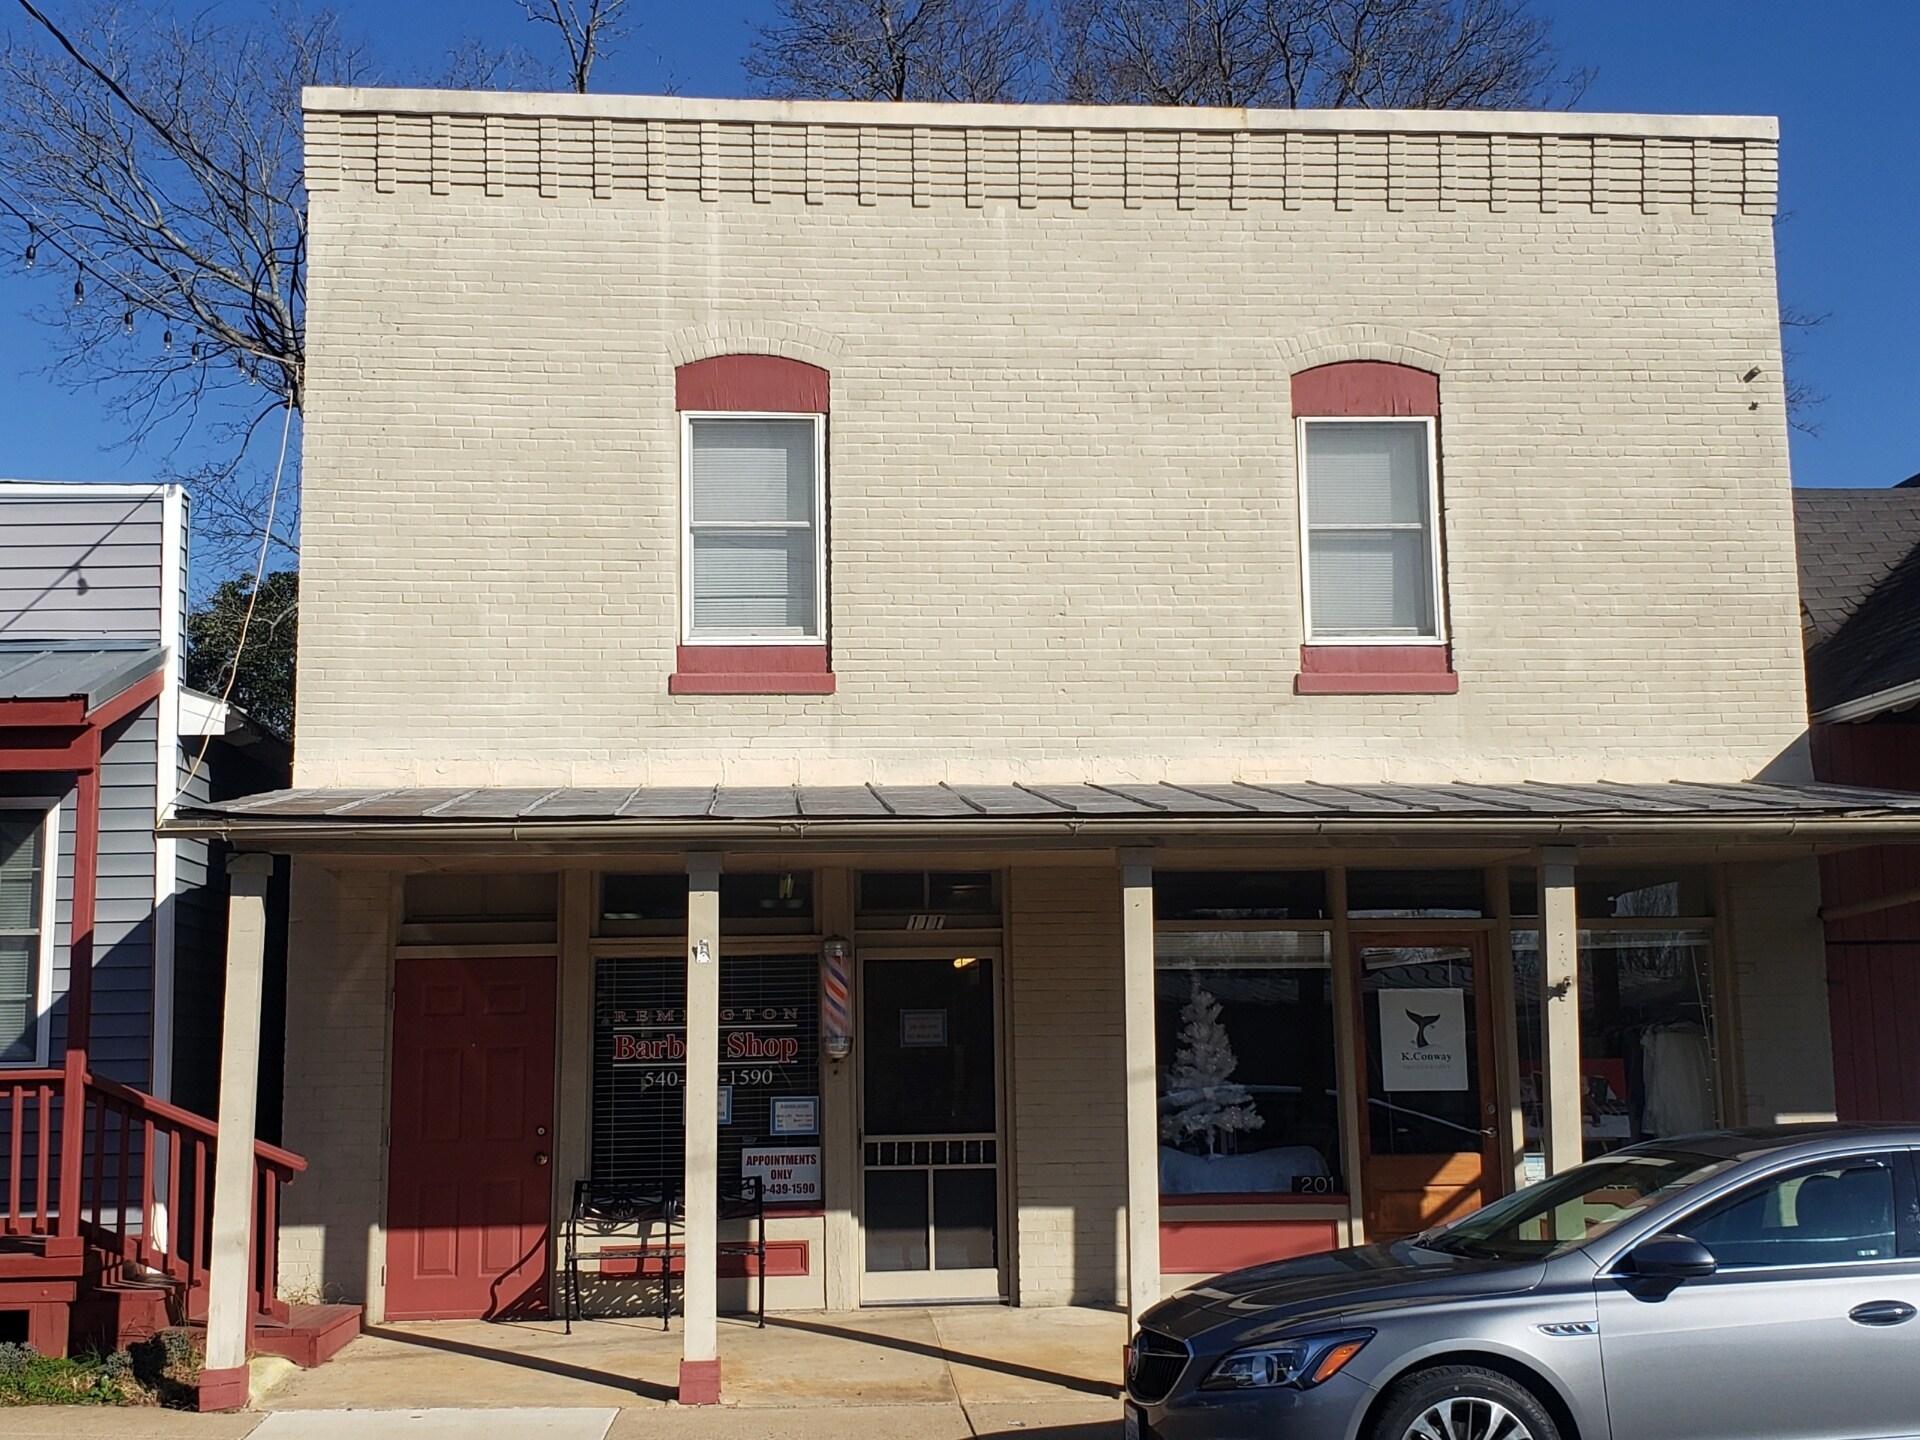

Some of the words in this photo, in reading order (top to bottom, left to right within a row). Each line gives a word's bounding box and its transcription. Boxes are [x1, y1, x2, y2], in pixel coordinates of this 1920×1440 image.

[613, 1008, 798, 1022] REMIGTON
[613, 1034, 688, 1060] Barb
[727, 1032, 798, 1063] Shop
[1401, 1052, 1452, 1062] K.Conway
[644, 1069, 773, 1087] 540--1590
[746, 1154, 817, 1166] APPOINTMENTS
[770, 1169, 793, 1180] ONLY
[748, 1183, 815, 1195] 0-439-1590
[1301, 1176, 1334, 1193] 201
